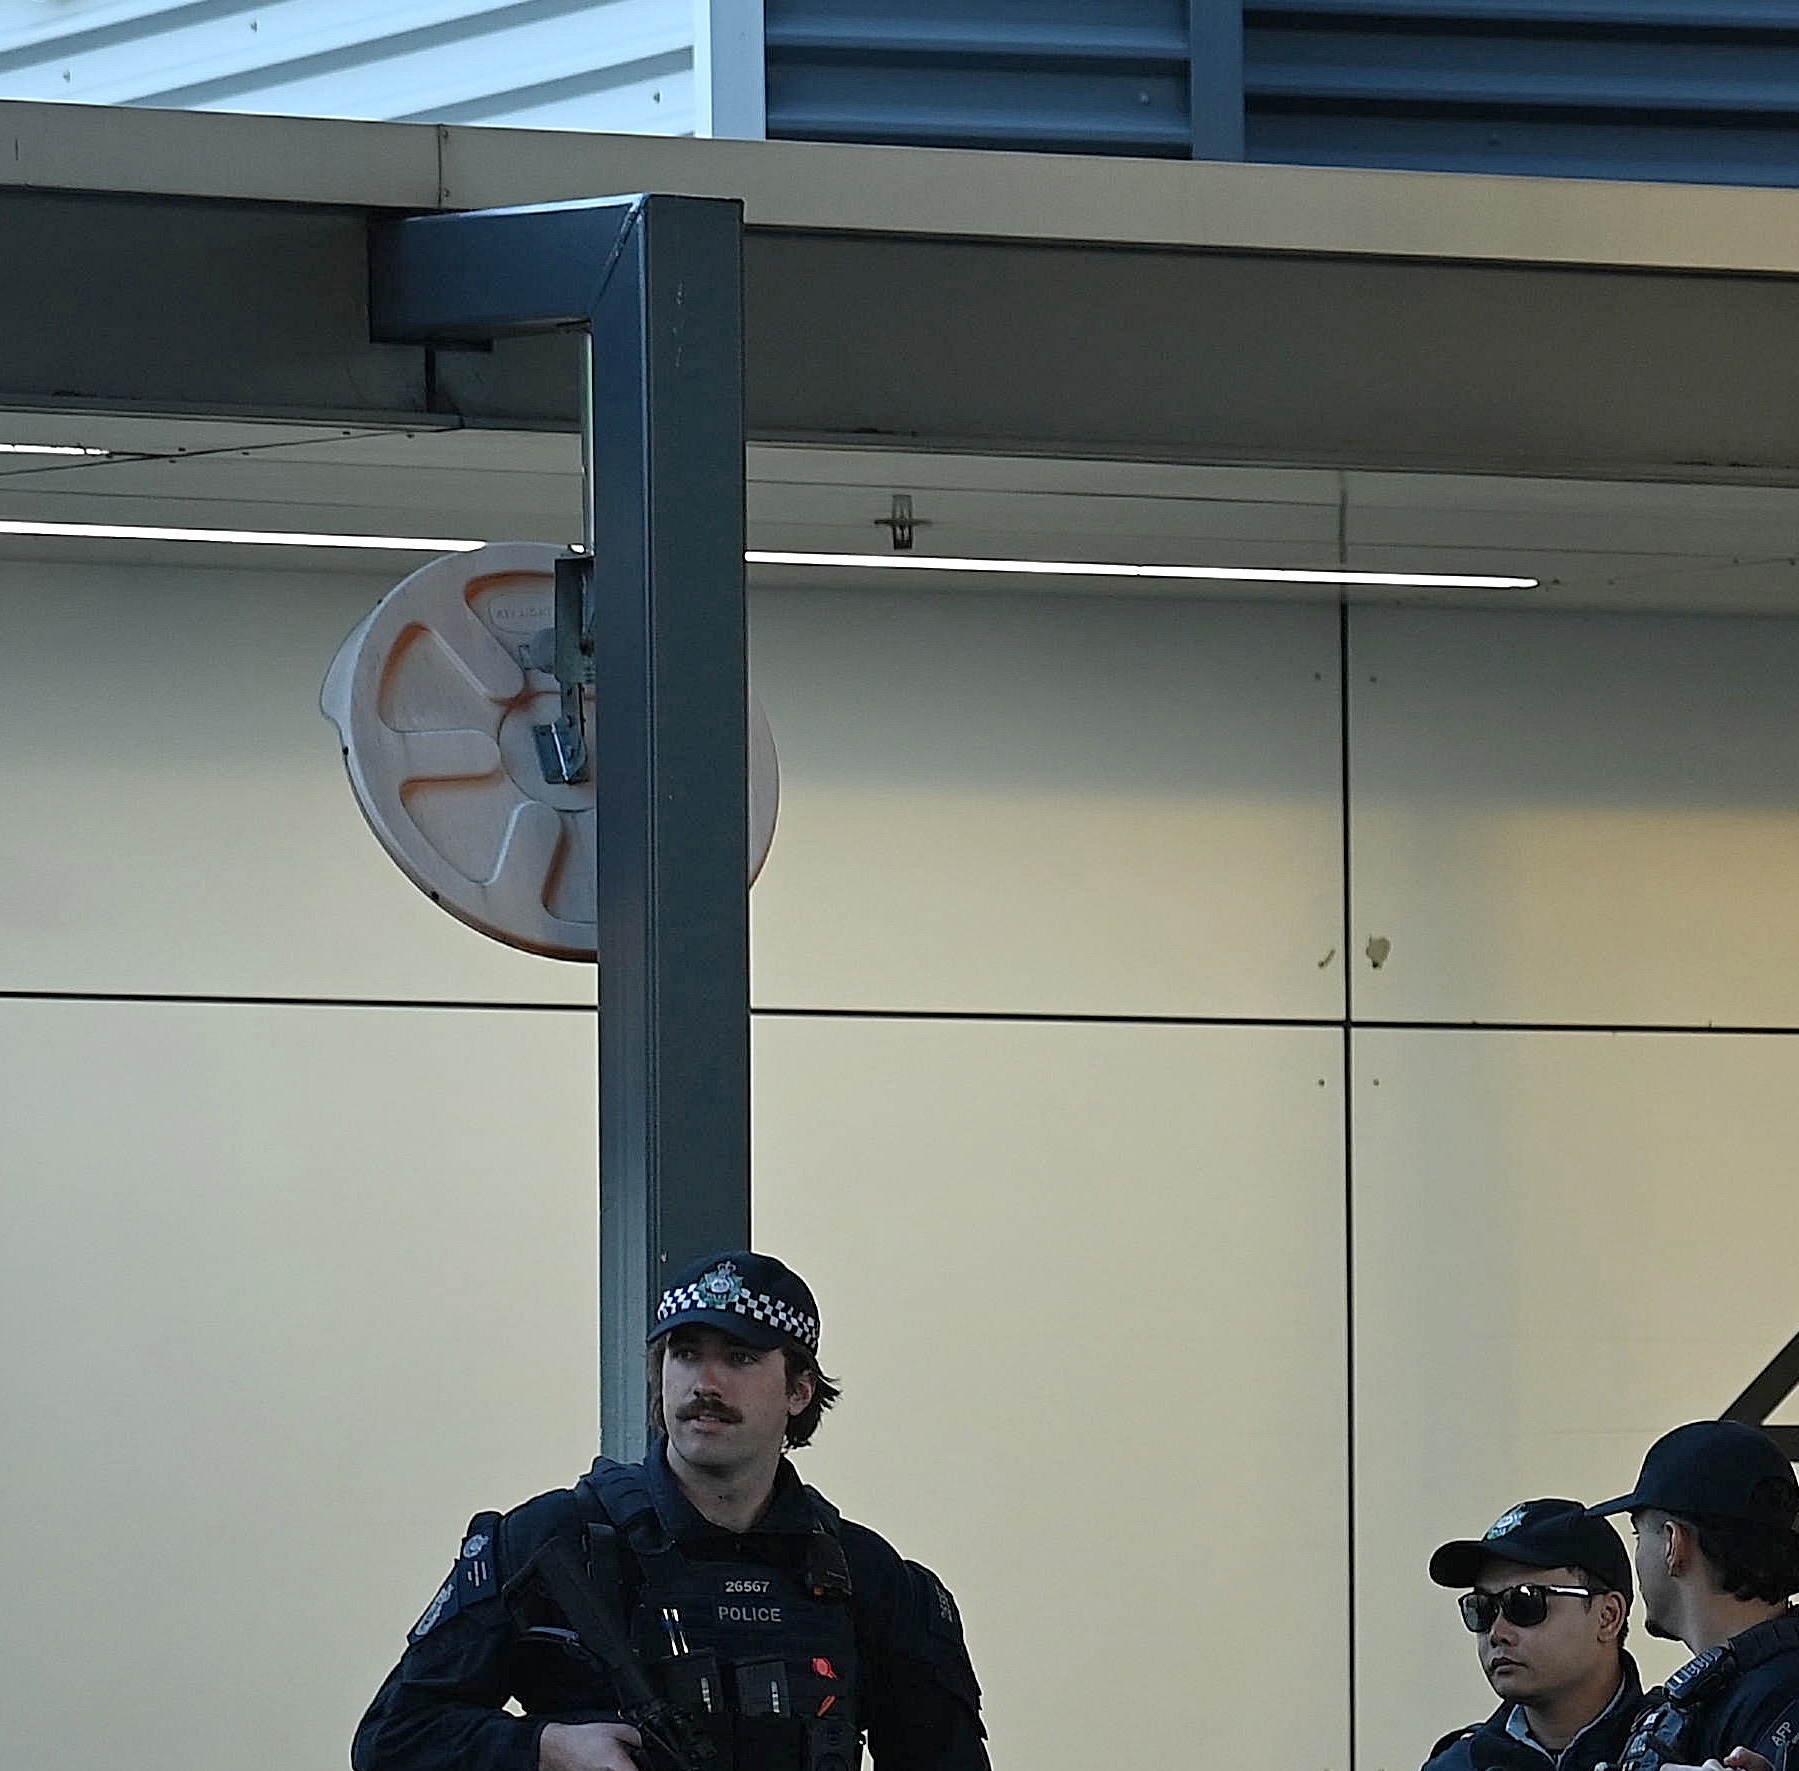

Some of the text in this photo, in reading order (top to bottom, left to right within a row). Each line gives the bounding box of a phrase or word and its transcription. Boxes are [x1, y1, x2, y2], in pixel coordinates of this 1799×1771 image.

[724, 1580, 771, 1593] 26567
[717, 1605, 782, 1622] POLICE
[1771, 1721, 1792, 1747] AFP
